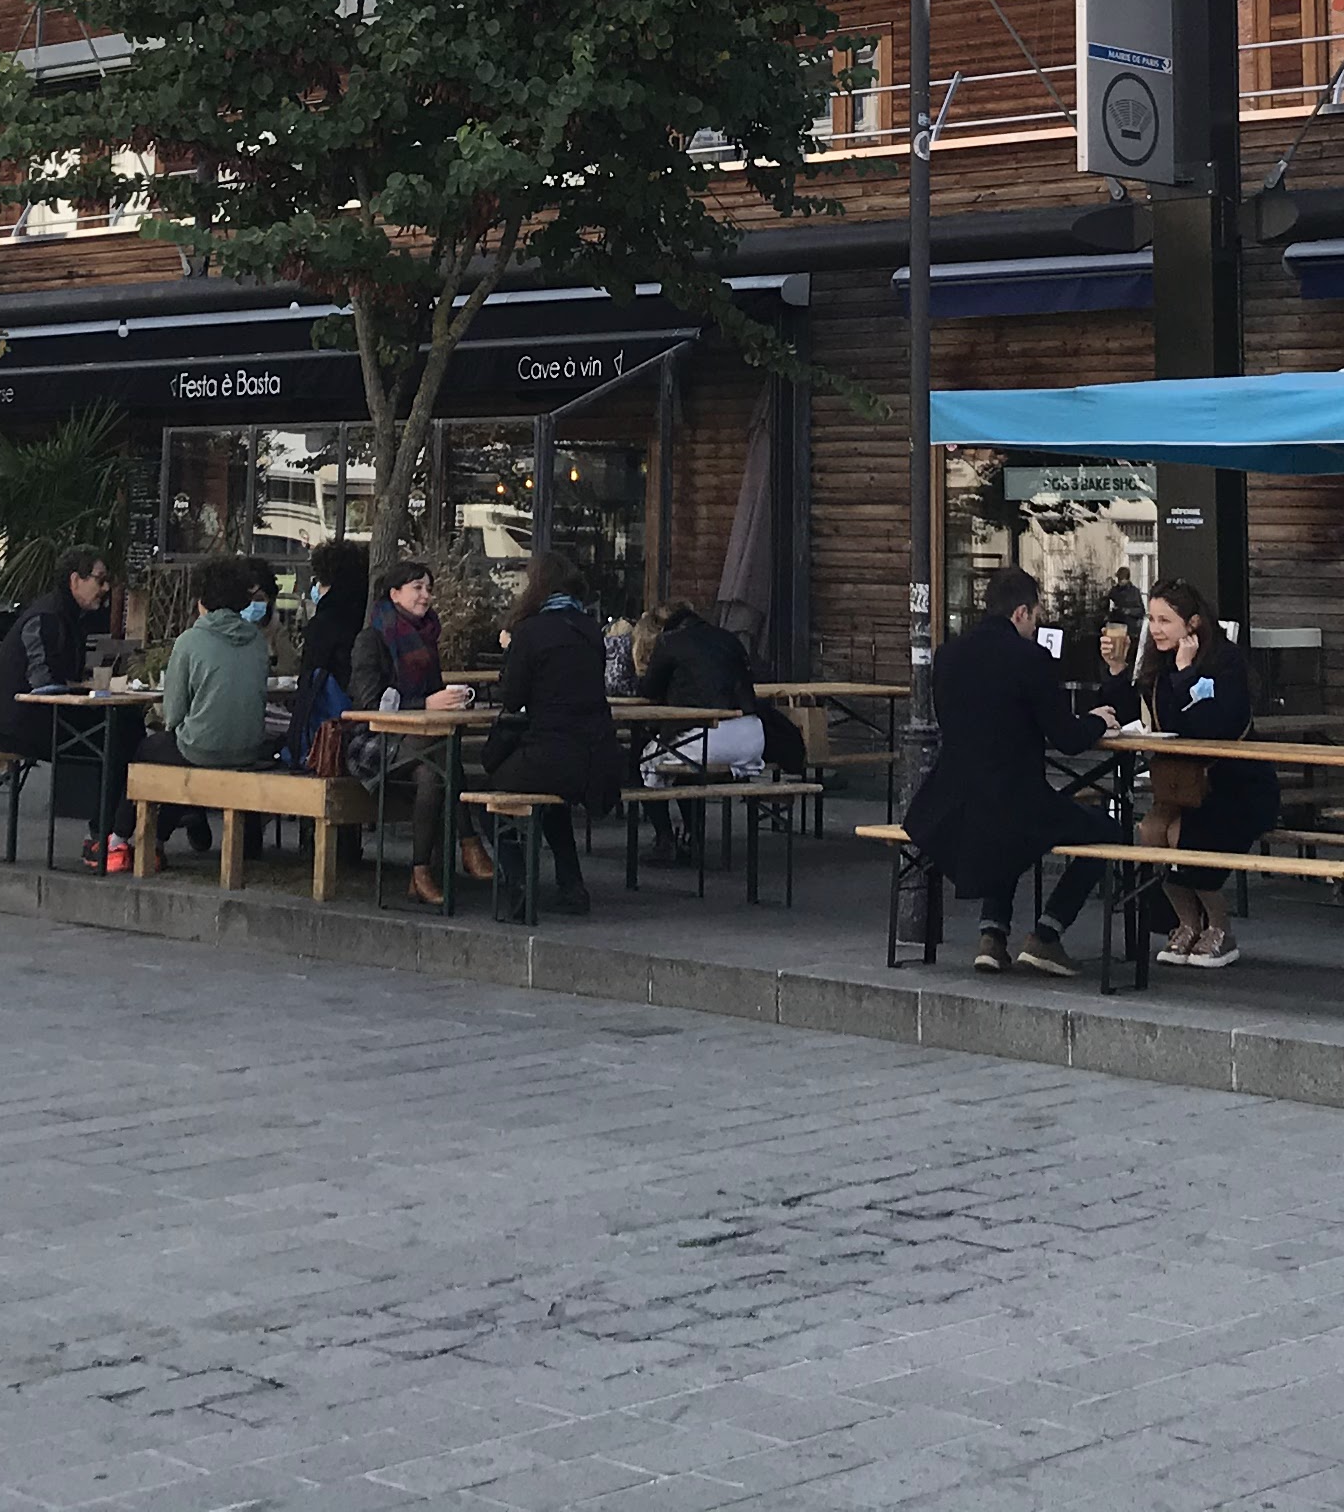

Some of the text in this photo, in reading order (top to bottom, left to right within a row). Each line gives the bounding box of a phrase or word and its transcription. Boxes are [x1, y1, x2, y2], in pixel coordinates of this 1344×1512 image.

[1108, 49, 1160, 68] MAIRIE DE PARIS
[517, 355, 602, 380] Cave à vin
[179, 369, 281, 398] Festa è Basta
[1045, 633, 1054, 651] 5
